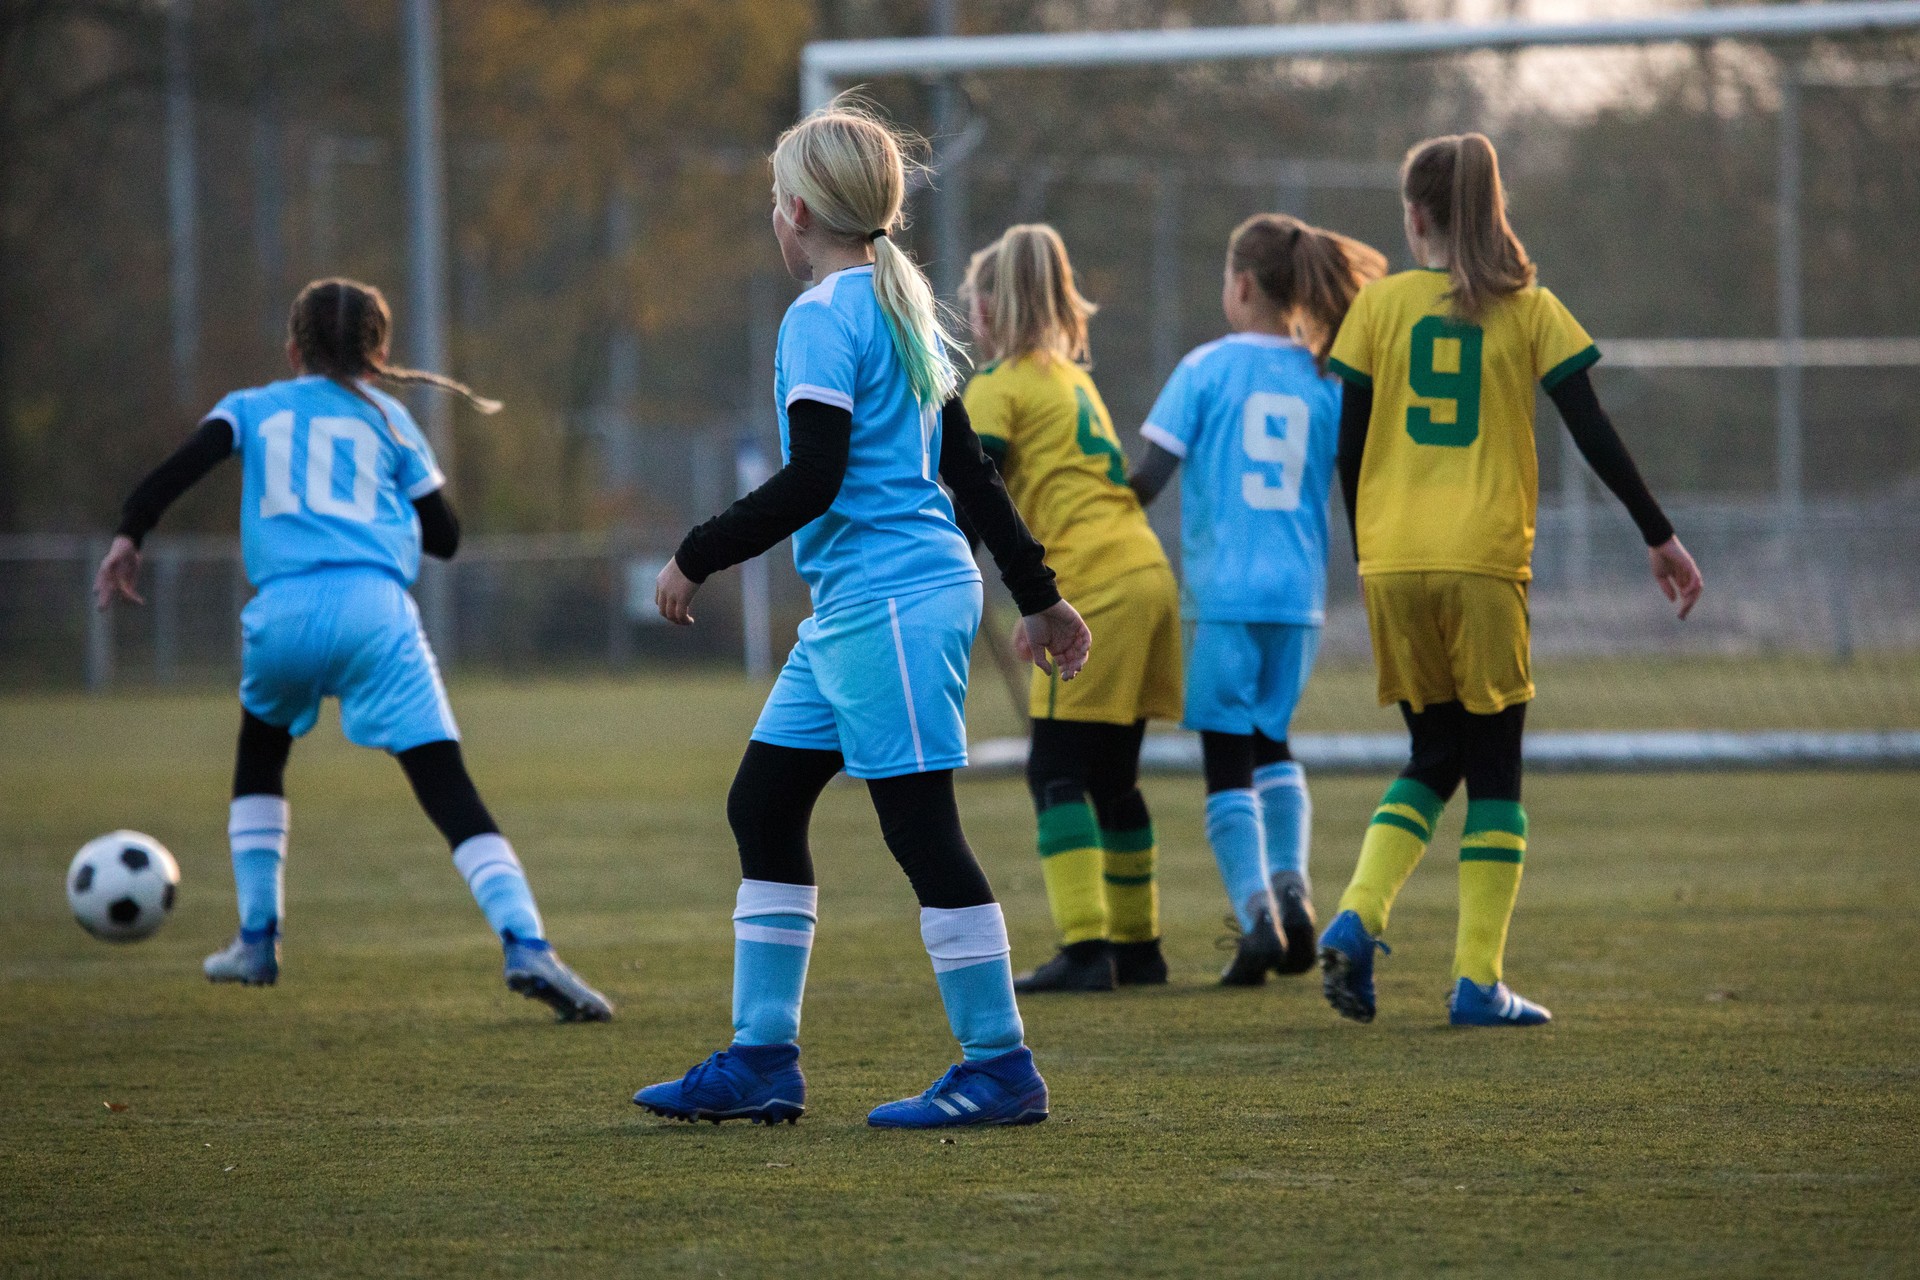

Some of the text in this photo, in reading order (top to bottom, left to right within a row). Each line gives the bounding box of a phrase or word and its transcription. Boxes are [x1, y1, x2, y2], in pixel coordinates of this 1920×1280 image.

[1074, 384, 1130, 487] 4
[1405, 314, 1484, 446] 9
[258, 409, 380, 523] 10
[1242, 391, 1309, 511] 9
